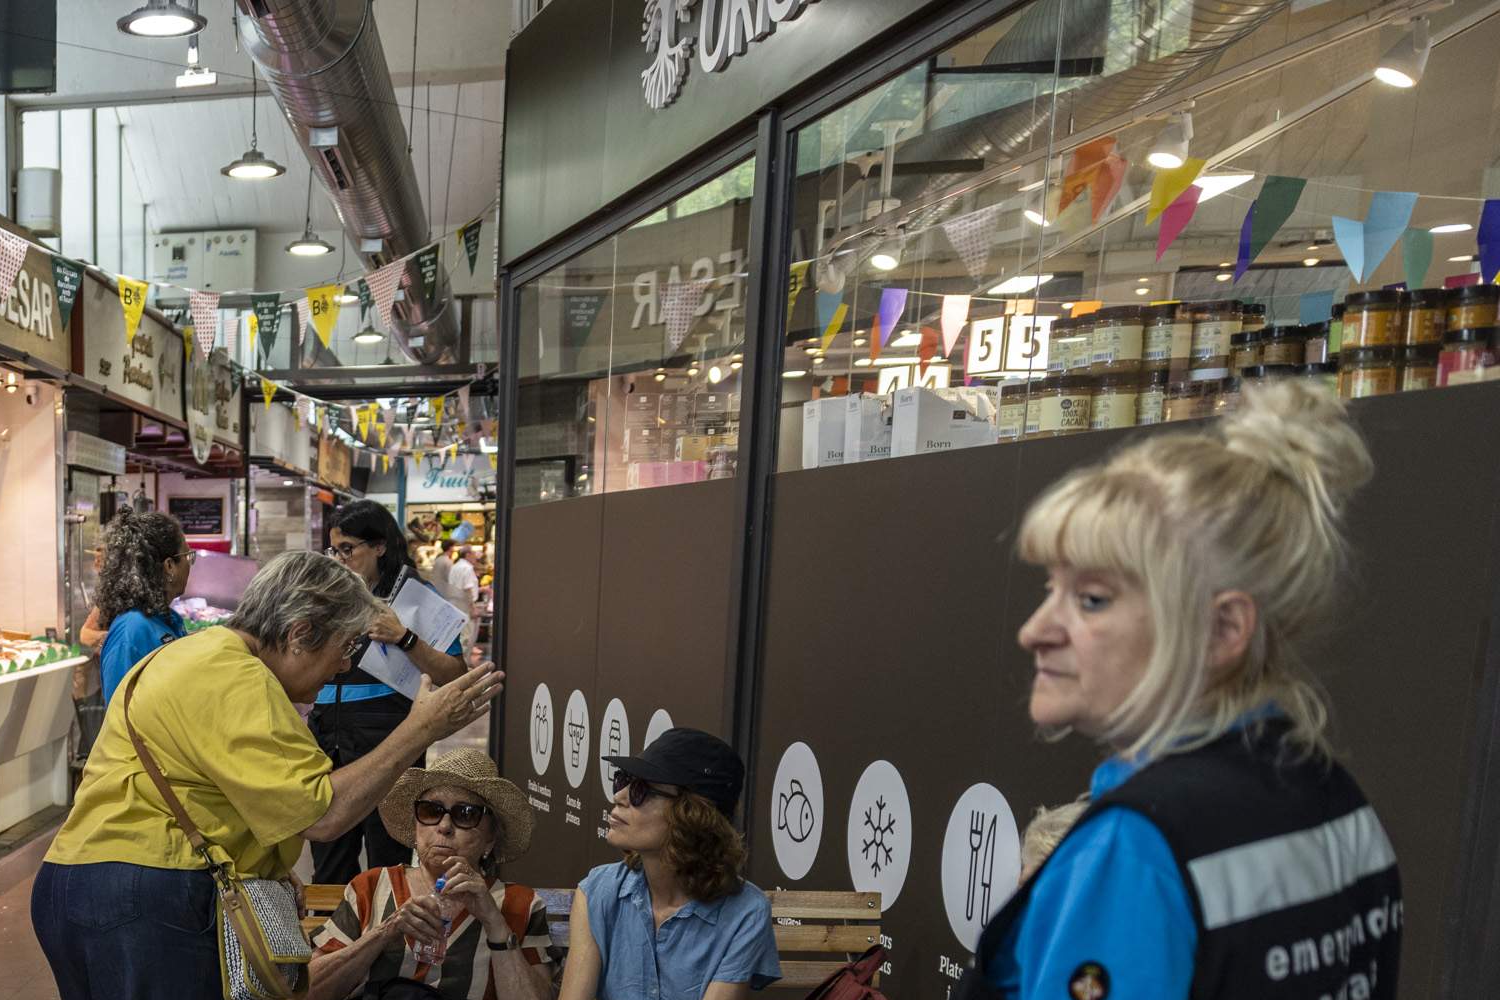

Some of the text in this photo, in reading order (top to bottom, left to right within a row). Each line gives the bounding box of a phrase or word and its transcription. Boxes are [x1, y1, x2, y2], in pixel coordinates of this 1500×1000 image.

[124, 287, 133, 305] B
[978, 329, 993, 362] 5
[1021, 326, 1042, 359] 5
[926, 440, 952, 449] Born
[827, 450, 845, 460] Bor
